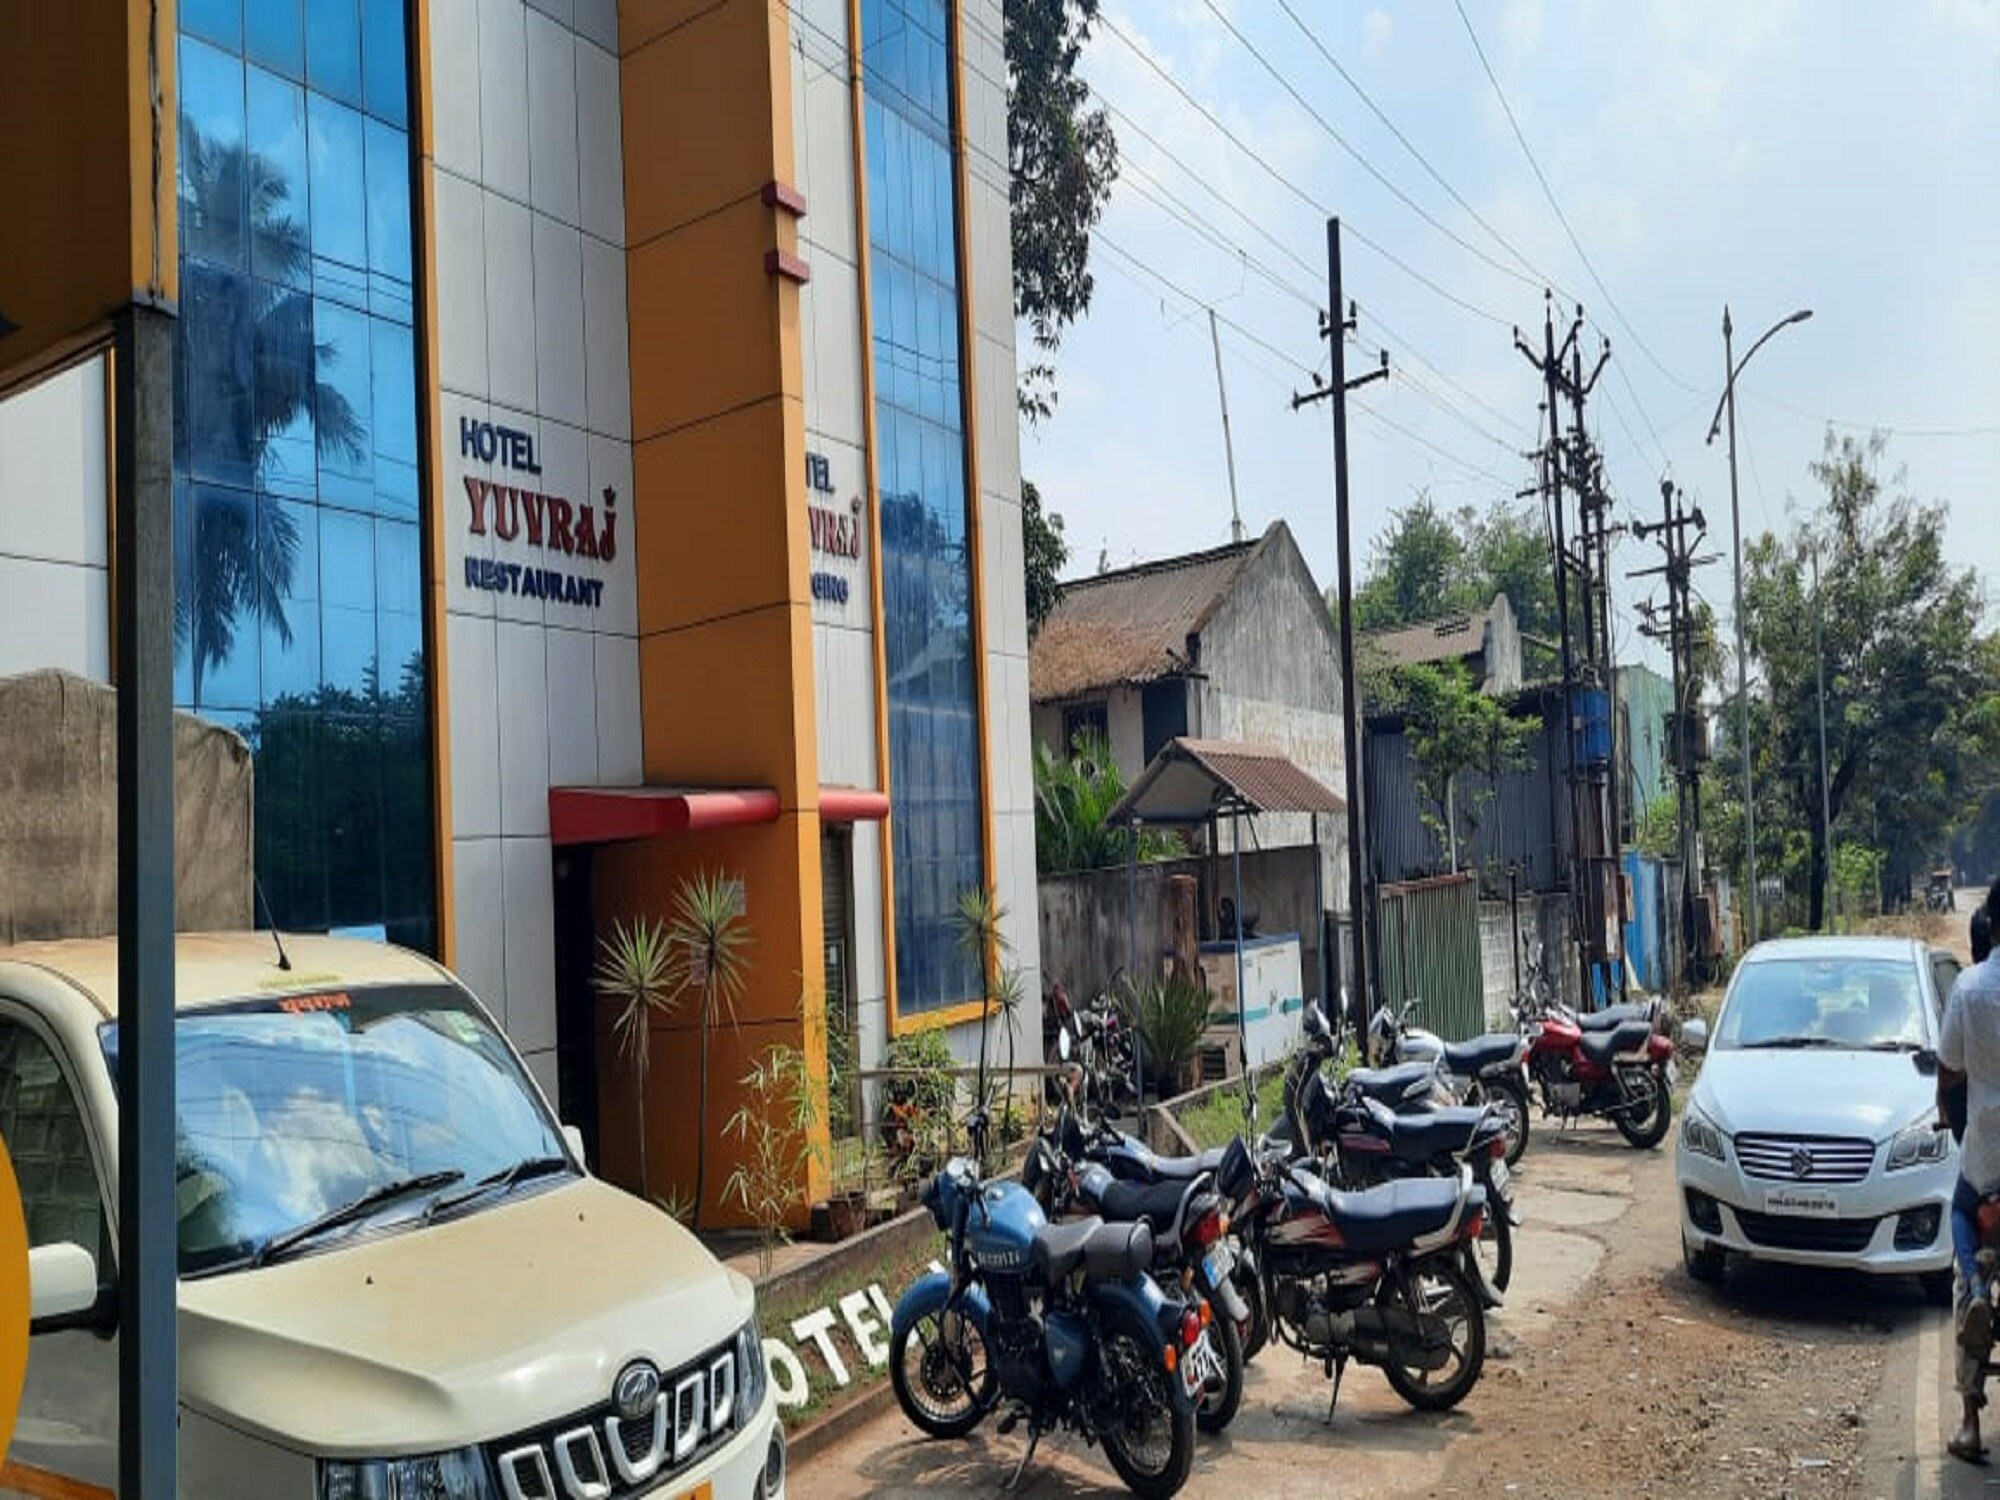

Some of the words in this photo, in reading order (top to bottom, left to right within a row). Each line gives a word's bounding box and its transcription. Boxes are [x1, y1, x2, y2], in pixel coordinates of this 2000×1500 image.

[460, 416, 542, 475] HOTEL
[806, 451, 835, 494] TEL
[463, 475, 617, 562] YUVRAJ
[808, 496, 862, 560] VRAJ
[464, 555, 604, 608] RESTAURANT
